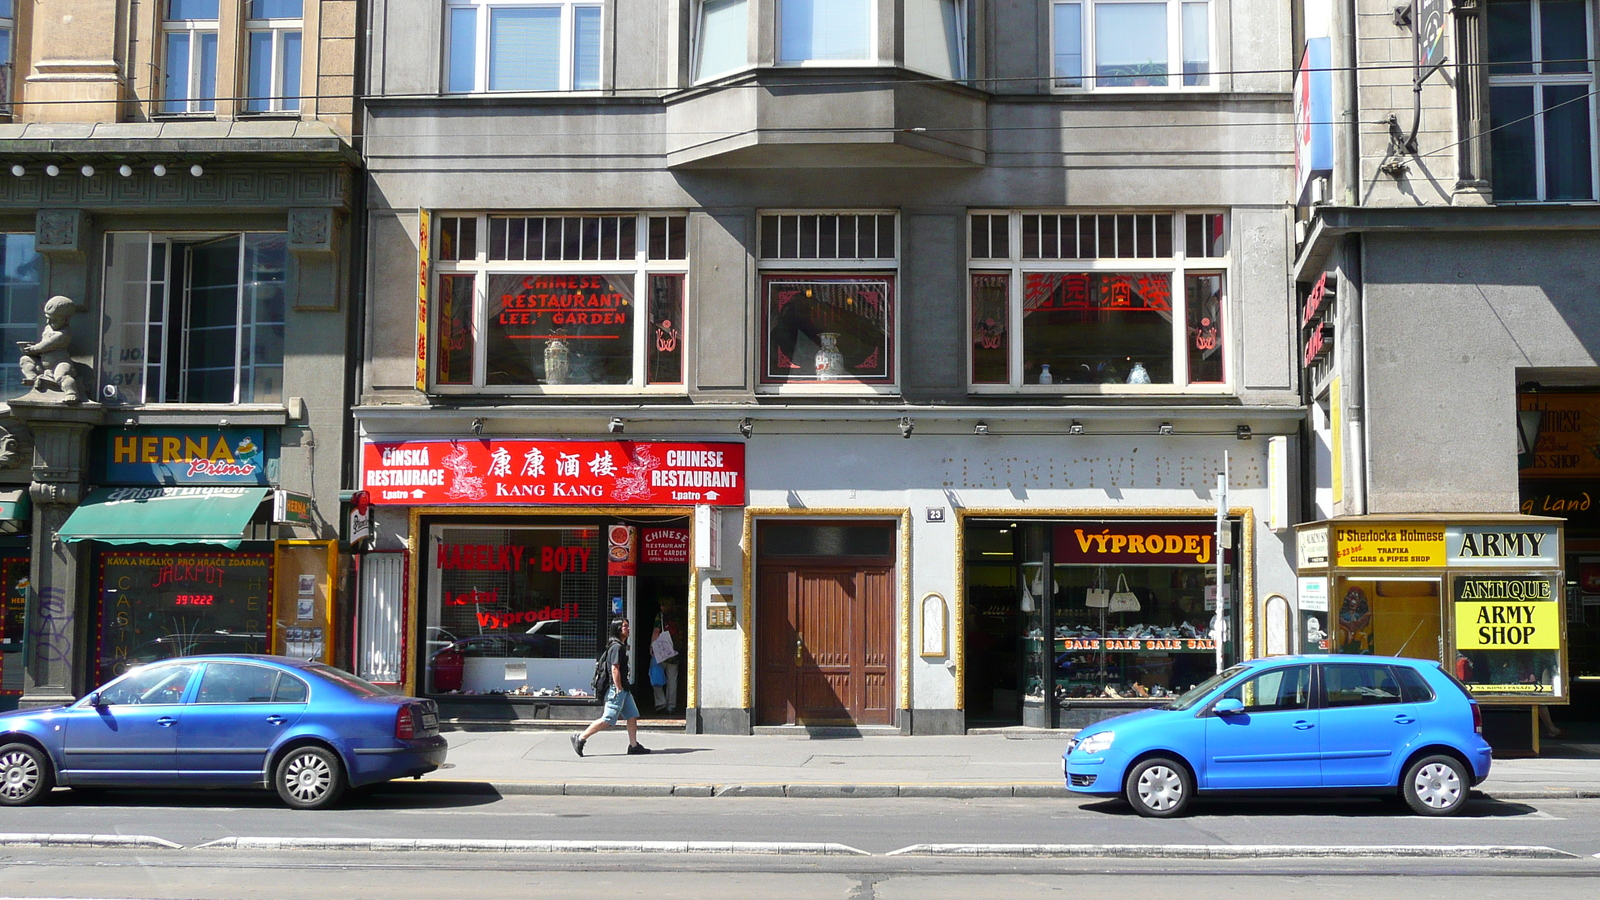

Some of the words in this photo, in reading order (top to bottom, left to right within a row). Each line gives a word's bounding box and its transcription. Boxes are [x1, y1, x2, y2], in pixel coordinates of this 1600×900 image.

[522, 276, 601, 289] CHINESE
[501, 293, 623, 308] RESTAURANT
[552, 313, 626, 325] GARDEN
[114, 436, 235, 464] HERNA
[382, 446, 430, 467] ČÍNSKÁ
[666, 450, 724, 468] CHINESE
[187, 457, 255, 477] Primo
[487, 447, 618, 478] 康康酒楼
[1550, 455, 1581, 468] SHOP
[366, 469, 445, 486] RESTAURACE
[651, 470, 739, 488] RESTAURANT
[382, 489, 409, 501] 1.patro
[496, 482, 546, 497] KANG
[552, 482, 604, 497] KANG
[671, 490, 701, 501] 1.patro
[930, 510, 941, 519] 23
[645, 530, 688, 543] CHINESE
[1337, 529, 1345, 542] U
[1347, 529, 1397, 542] Sherlocka
[1400, 529, 1444, 542] Holmese
[1074, 528, 1212, 563] VÝPRODEJ
[1458, 532, 1546, 558] ARMY
[130, 558, 137, 566] A
[139, 558, 174, 566] NEALKO
[178, 558, 196, 566] PRO
[197, 557, 226, 567] HRÁČE
[228, 559, 265, 567] ZDARMA
[437, 543, 525, 572] KABELKY
[541, 546, 591, 573] BOTY
[152, 562, 225, 588] JACKPOT
[444, 587, 500, 606] Letní
[1461, 580, 1551, 601] ANTIQUE
[175, 594, 214, 606] 397222
[476, 603, 579, 630] Výprodej!
[1476, 605, 1536, 624] ARMY
[1064, 639, 1100, 650] SALE
[1105, 639, 1141, 650] SALE
[1146, 639, 1182, 650] SALE
[1478, 626, 1536, 645] SHOP
